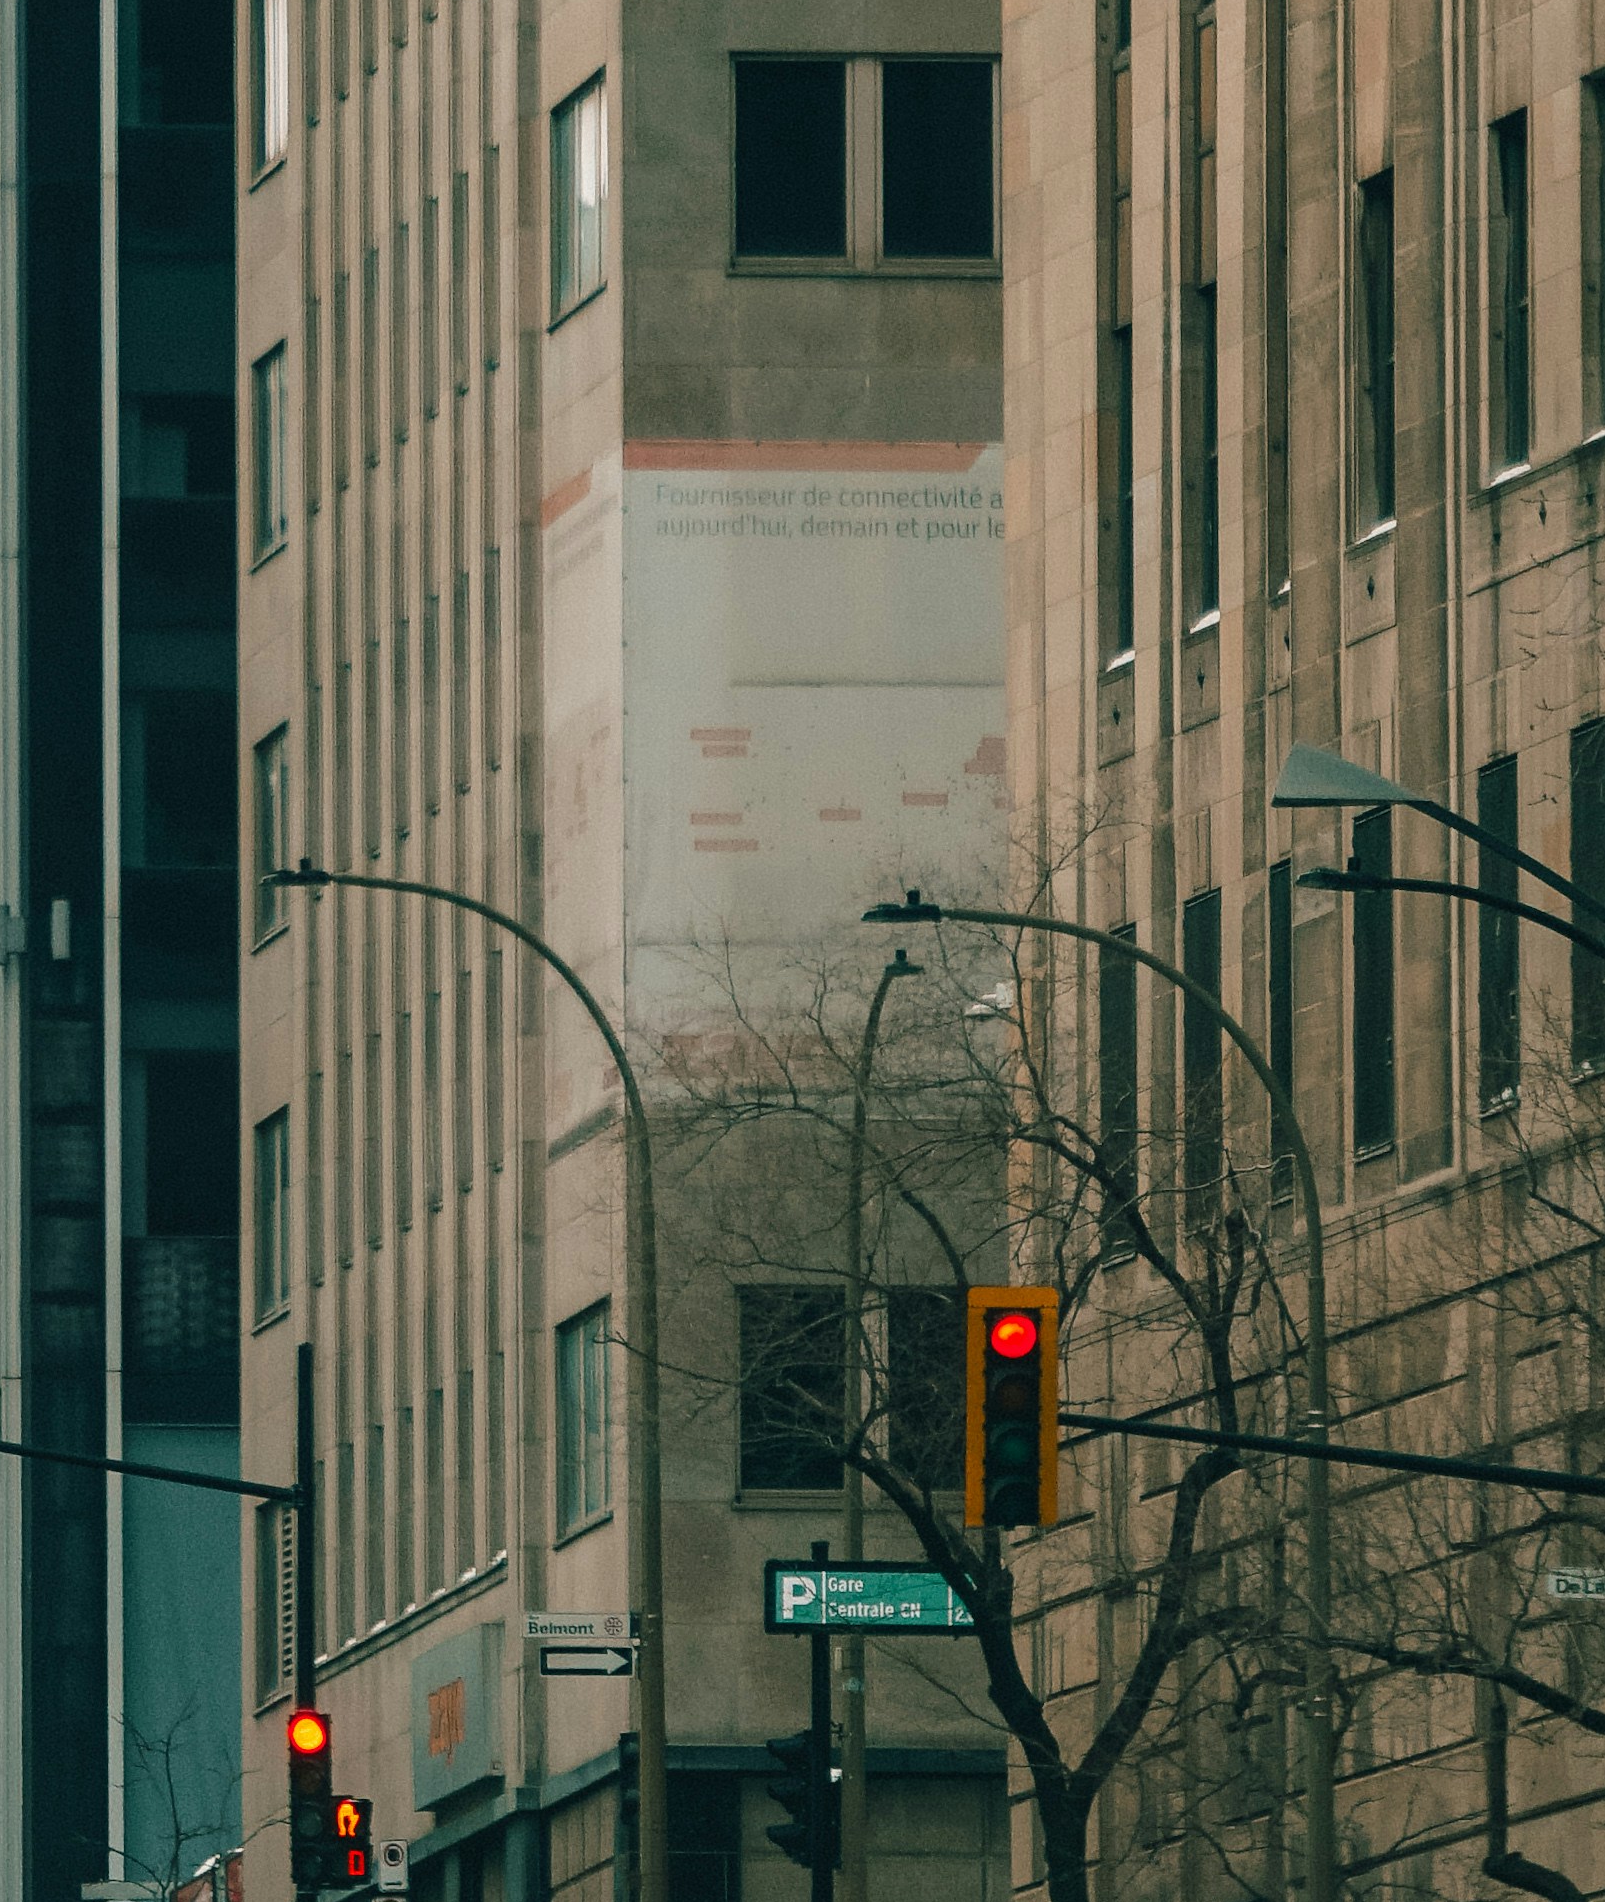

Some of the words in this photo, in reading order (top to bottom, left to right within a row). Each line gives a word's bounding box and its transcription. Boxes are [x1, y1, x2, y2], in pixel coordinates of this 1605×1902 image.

[657, 484, 795, 506] Fournisseur
[803, 484, 831, 507] de
[839, 483, 982, 509] connectivité
[656, 514, 793, 539] aujourd'hui,
[800, 514, 888, 538] demain
[896, 516, 920, 539] et
[927, 520, 980, 544] pour
[828, 1577, 864, 1593] Gare
[1556, 1579, 1580, 1594] De
[782, 1576, 817, 1620] P
[827, 1601, 895, 1619] Centrale
[900, 1602, 922, 1619] CN
[528, 1621, 595, 1635] Belmont
